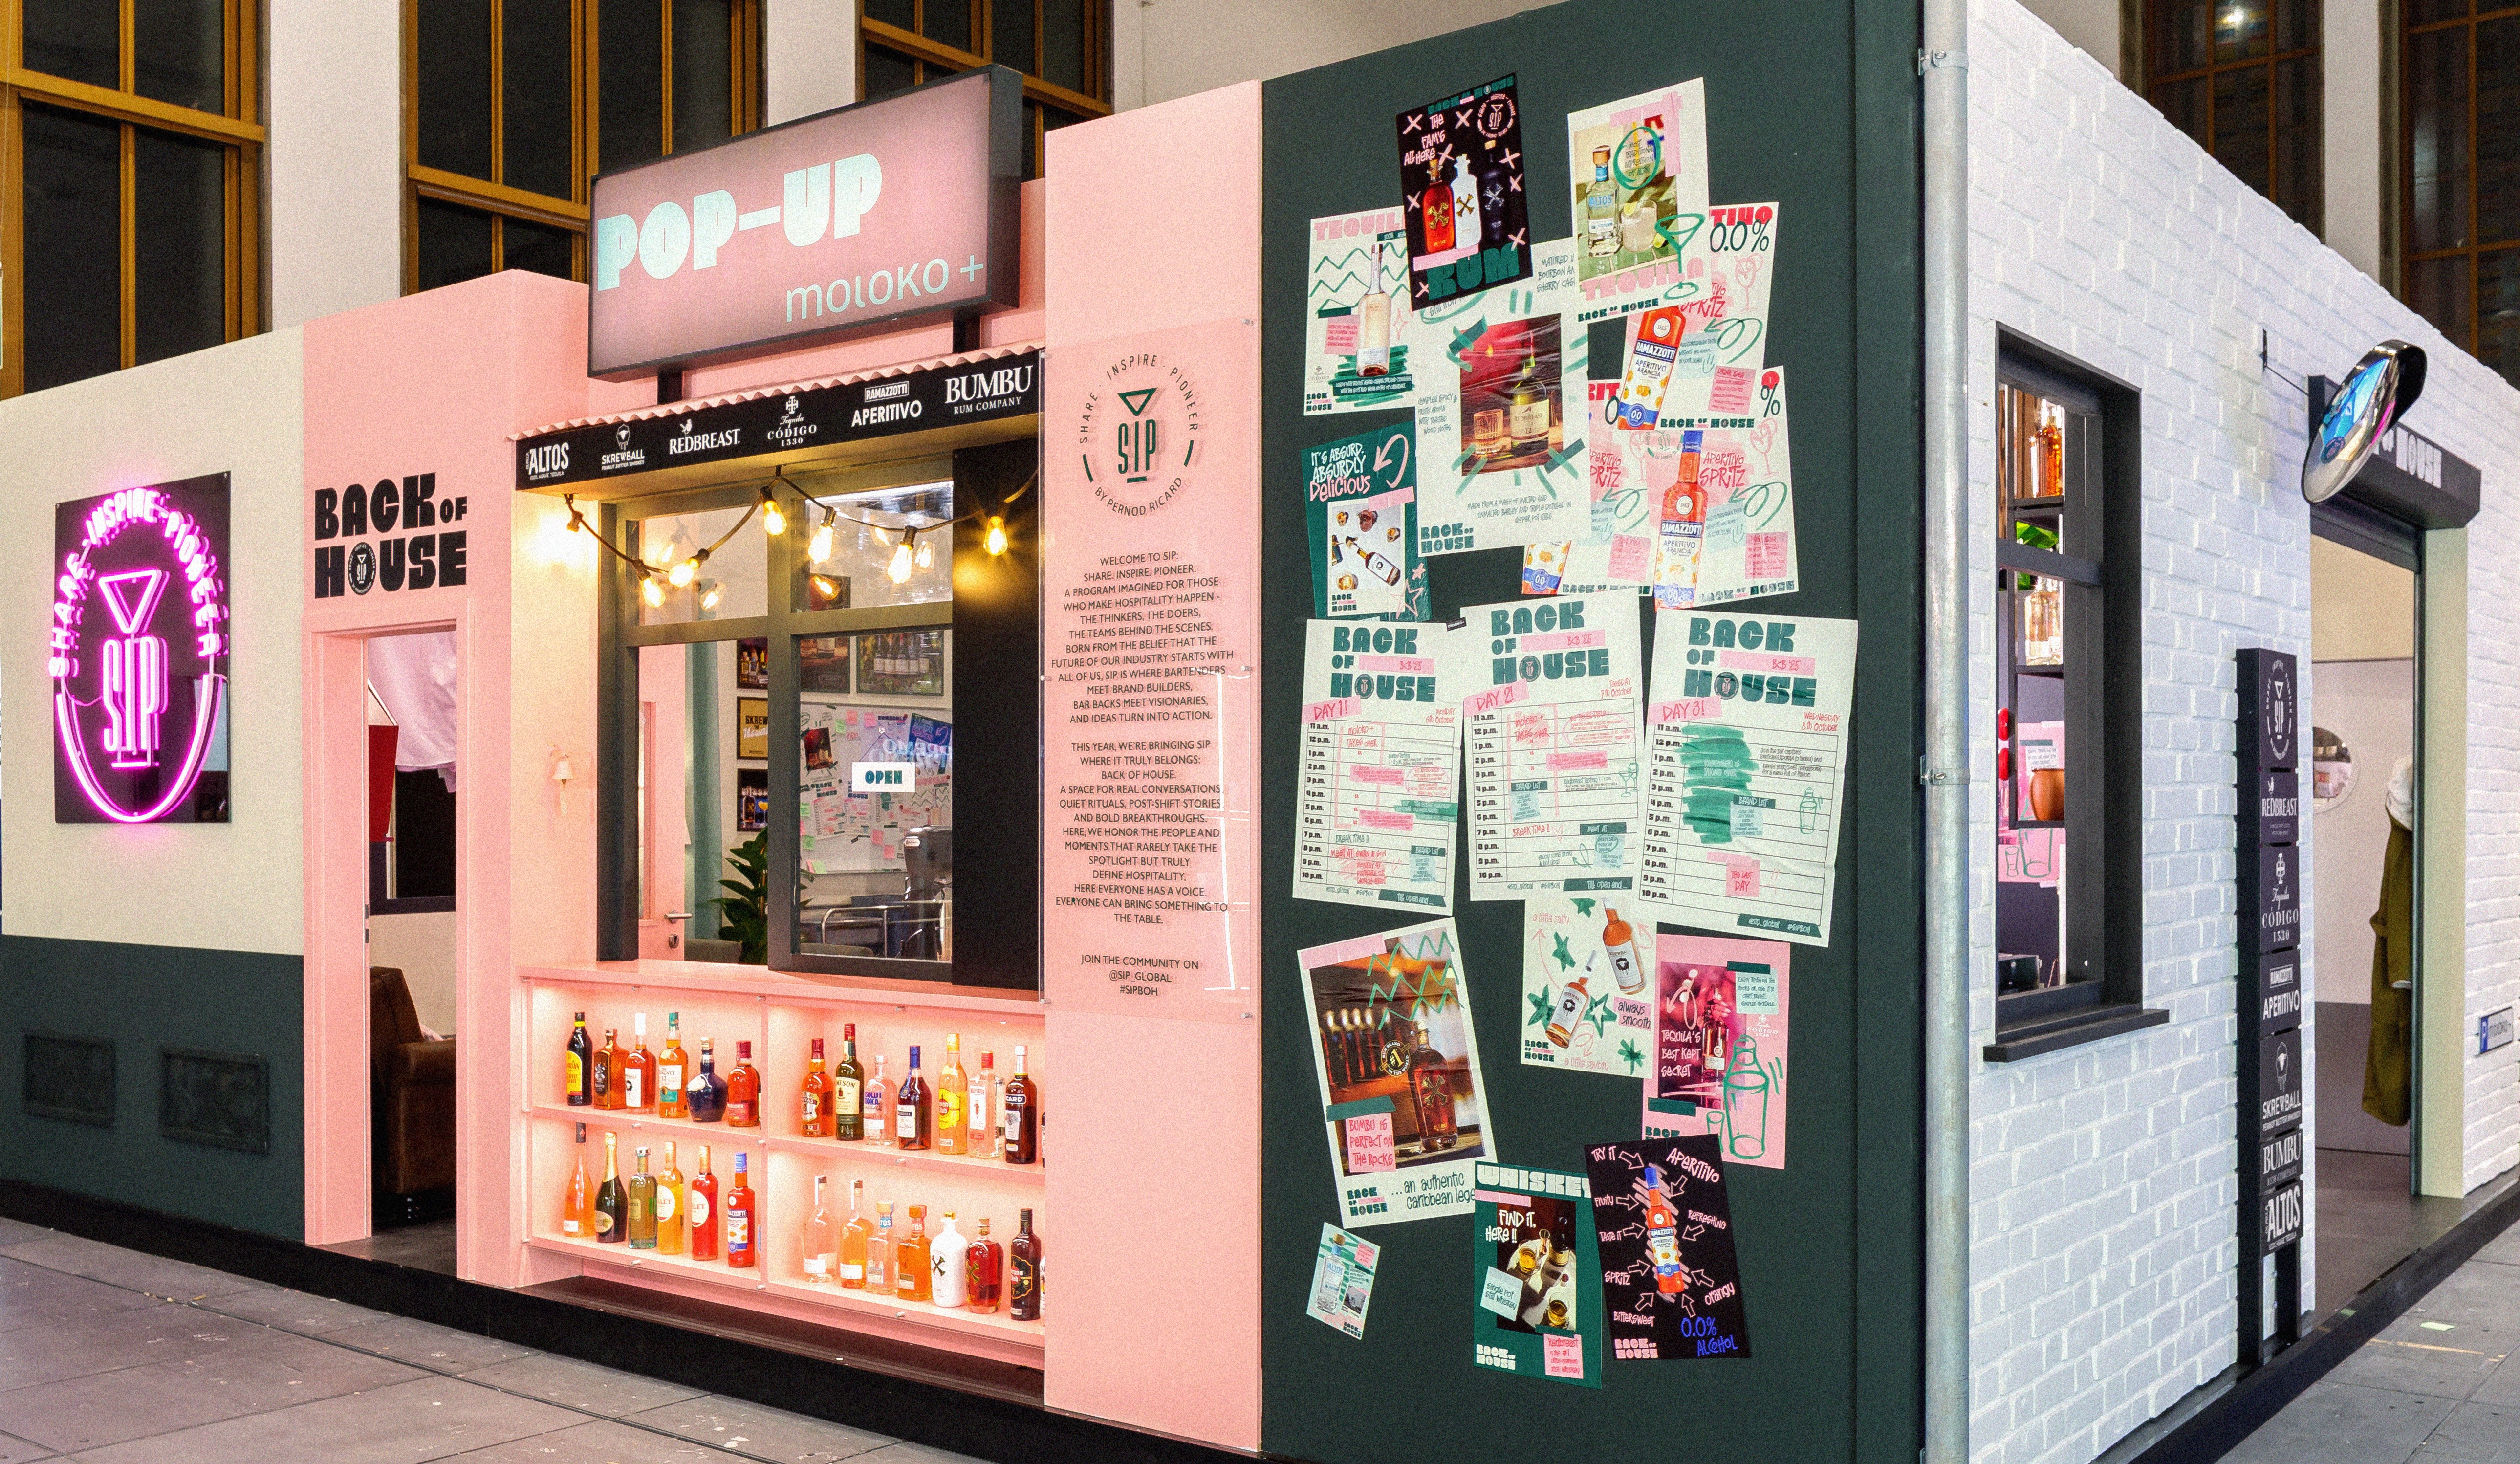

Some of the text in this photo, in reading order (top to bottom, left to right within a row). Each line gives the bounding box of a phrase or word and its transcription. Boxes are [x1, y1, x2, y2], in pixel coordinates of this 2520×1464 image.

[1489, 112, 1502, 128] SIP
[598, 153, 882, 291] POP-UP
[1314, 212, 1404, 241] TEQUIL
[1710, 219, 1770, 253] 0.0%
[1427, 244, 1519, 300] RUM
[1581, 258, 1704, 301] TEQUILA
[1578, 309, 1607, 322] BACK
[1621, 298, 1659, 313] HOUSE
[1636, 342, 1676, 362] RAMAZZOTTI
[1635, 360, 1666, 372] APERITIVO
[1637, 367, 1661, 376] ARANCIA
[866, 382, 908, 400] RAMAZZOTTI
[945, 366, 1033, 404] BUMBU
[954, 396, 1021, 415] RUM COMPANY
[1079, 354, 1198, 444] SHARE INSPIRE PIONEER
[852, 400, 922, 427] APERITIVO
[1514, 414, 1542, 422] REDBREAST
[1661, 418, 1696, 428] BACK
[1711, 418, 1754, 428] HOUSE
[767, 424, 817, 440] CÓDIGO
[669, 429, 740, 455] REDBREAST
[781, 438, 803, 446] 1530
[1118, 419, 1156, 474] SIP
[529, 442, 569, 474] ALTOS
[602, 449, 645, 464] SKREWBALL
[1311, 443, 1364, 466] IT'S ABSURD.
[1313, 455, 1366, 483] ABSURDLY
[1095, 477, 1182, 516] BY PERNOD RICARD
[1310, 475, 1371, 502] Delicious
[315, 473, 467, 540] BACK OF
[1422, 523, 1463, 540] BACK
[1662, 522, 1703, 536] RAMAZZOTTI
[1422, 536, 1474, 553] HOUSE
[315, 531, 467, 598] HOUSE
[1100, 551, 1178, 566] WELCOME TO SIP:
[49, 553, 81, 678] SHARE
[85, 487, 159, 543] INSPIRE
[1084, 564, 1195, 582] SHARE. INSPIRE. PIONEER.
[1073, 585, 1116, 596] PROGRAM
[1118, 581, 1163, 592] IMAGINED
[1166, 579, 1184, 589] FOR
[1187, 577, 1218, 587] THOSE
[1492, 601, 1584, 636] BACK
[1333, 627, 1418, 654] BACK
[1689, 617, 1795, 652] BACK
[1492, 638, 1516, 655] OF
[1332, 655, 1354, 669] OF
[1686, 648, 1714, 665] OF
[1493, 649, 1609, 685] HOUSE
[103, 637, 161, 752] SIP
[1087, 682, 1193, 695] MEET BRAND BUILDERS,
[1330, 673, 1436, 702] HOUSE
[1684, 669, 1816, 707] HOUSE
[1477, 690, 1499, 710] DAY
[1070, 711, 1212, 723] AND IDEAS TURN INTO ACTION.
[1314, 702, 1335, 720] DAY
[1663, 703, 1689, 720] DAY
[2275, 700, 2283, 733] SIP
[865, 770, 902, 784] OPEN
[1102, 770, 1176, 780] BACK OF HOUSE.
[2262, 798, 2297, 817] REDBREAST
[1093, 870, 1187, 881] DEFINE HOSPITALITY.
[1652, 890, 1668, 900] p.m.
[2273, 930, 2289, 942] 1530
[1081, 954, 1198, 969] JOIN THE COMMUNITY ON
[1120, 985, 1158, 996] #SIPBOH
[1618, 1001, 1646, 1015] always
[2263, 990, 2299, 1020] APERITIVO
[2262, 1090, 2301, 1119] SKREWBALL
[1591, 1148, 1608, 1161] TRY
[2263, 1132, 2301, 1174] BUMBU
[1421, 1171, 1464, 1191] authentic
[2267, 1185, 2300, 1242] ALTOS
[1681, 1317, 1717, 1337] 0.0%
[1477, 1344, 1507, 1359] BACK
[1614, 1339, 1648, 1349] BACK
[1477, 1355, 1515, 1370] HOUSE
[1616, 1349, 1658, 1359] HOUSE
